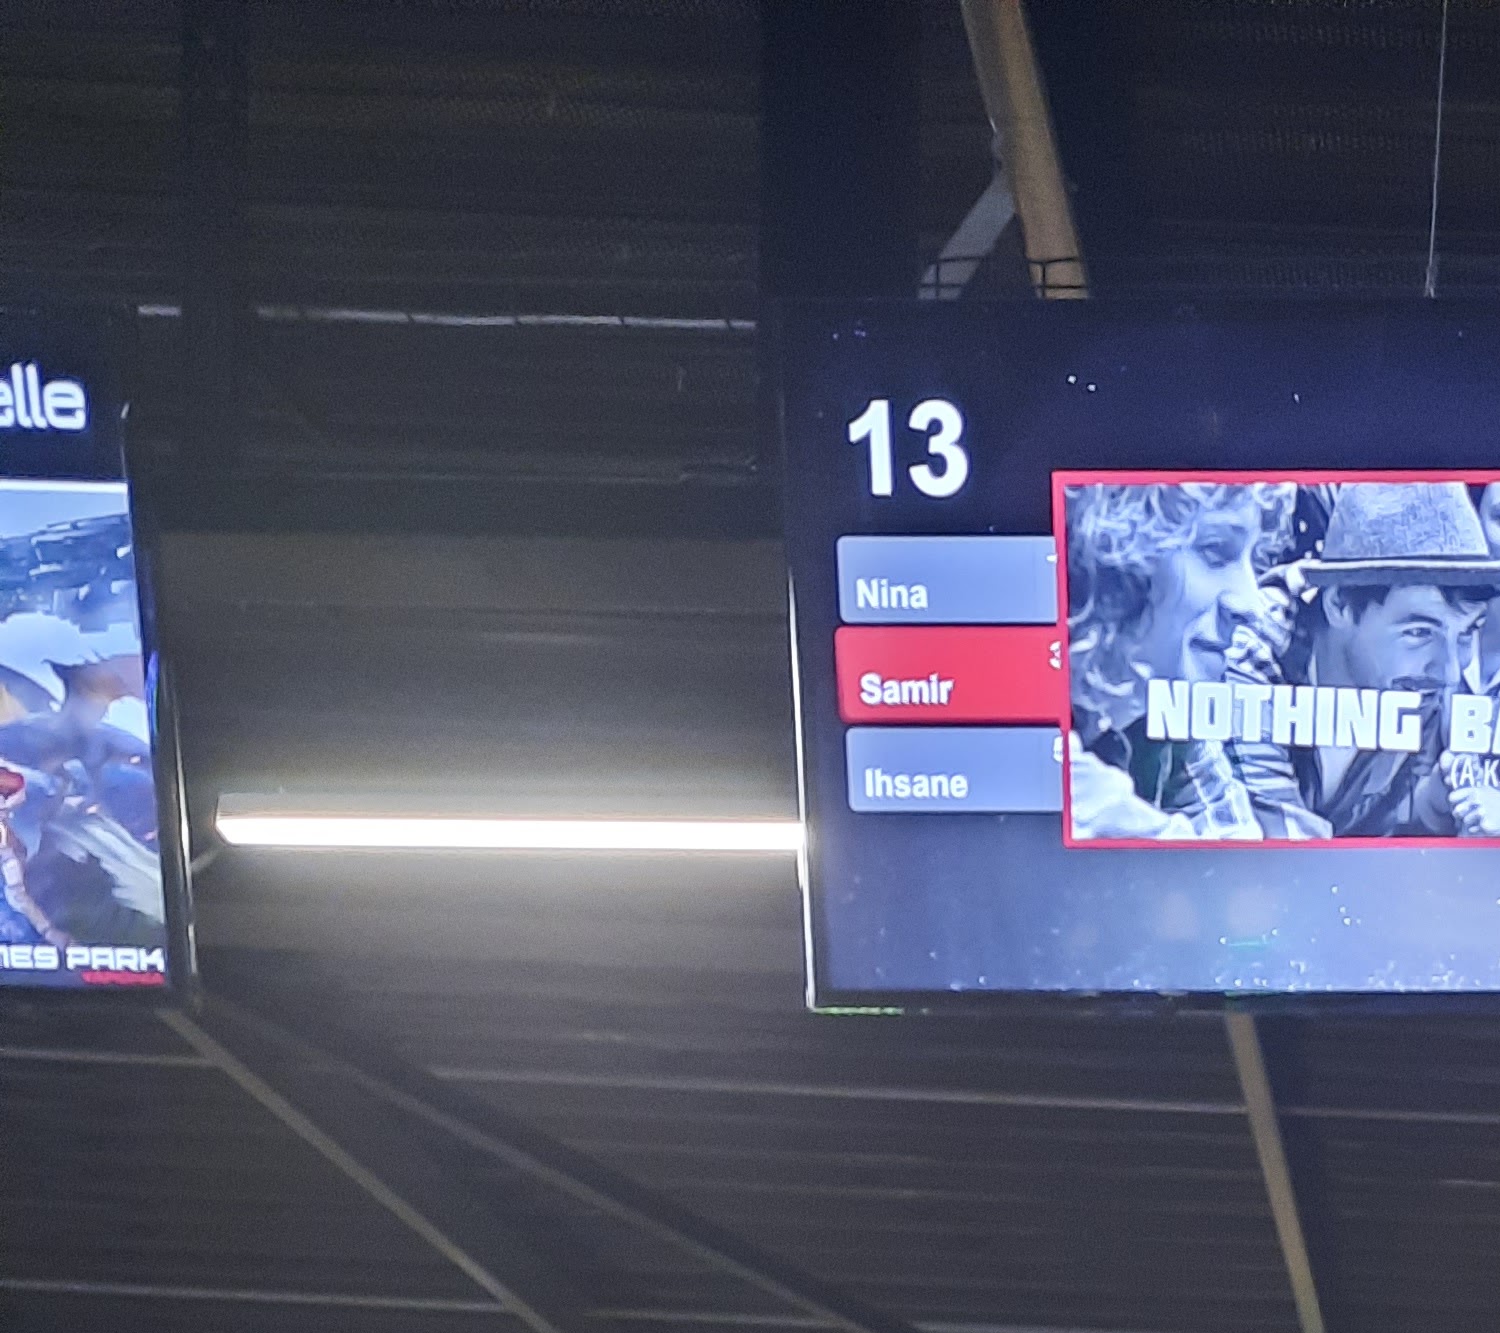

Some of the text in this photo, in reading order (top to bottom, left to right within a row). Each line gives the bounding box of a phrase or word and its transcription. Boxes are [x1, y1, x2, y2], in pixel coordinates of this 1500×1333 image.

[848, 399, 969, 498] 13
[856, 578, 929, 609] Nina
[859, 672, 955, 705] Samir
[1146, 679, 1421, 752] NOTHING
[864, 768, 969, 799] Ihsane
[66, 946, 165, 973] PARK
